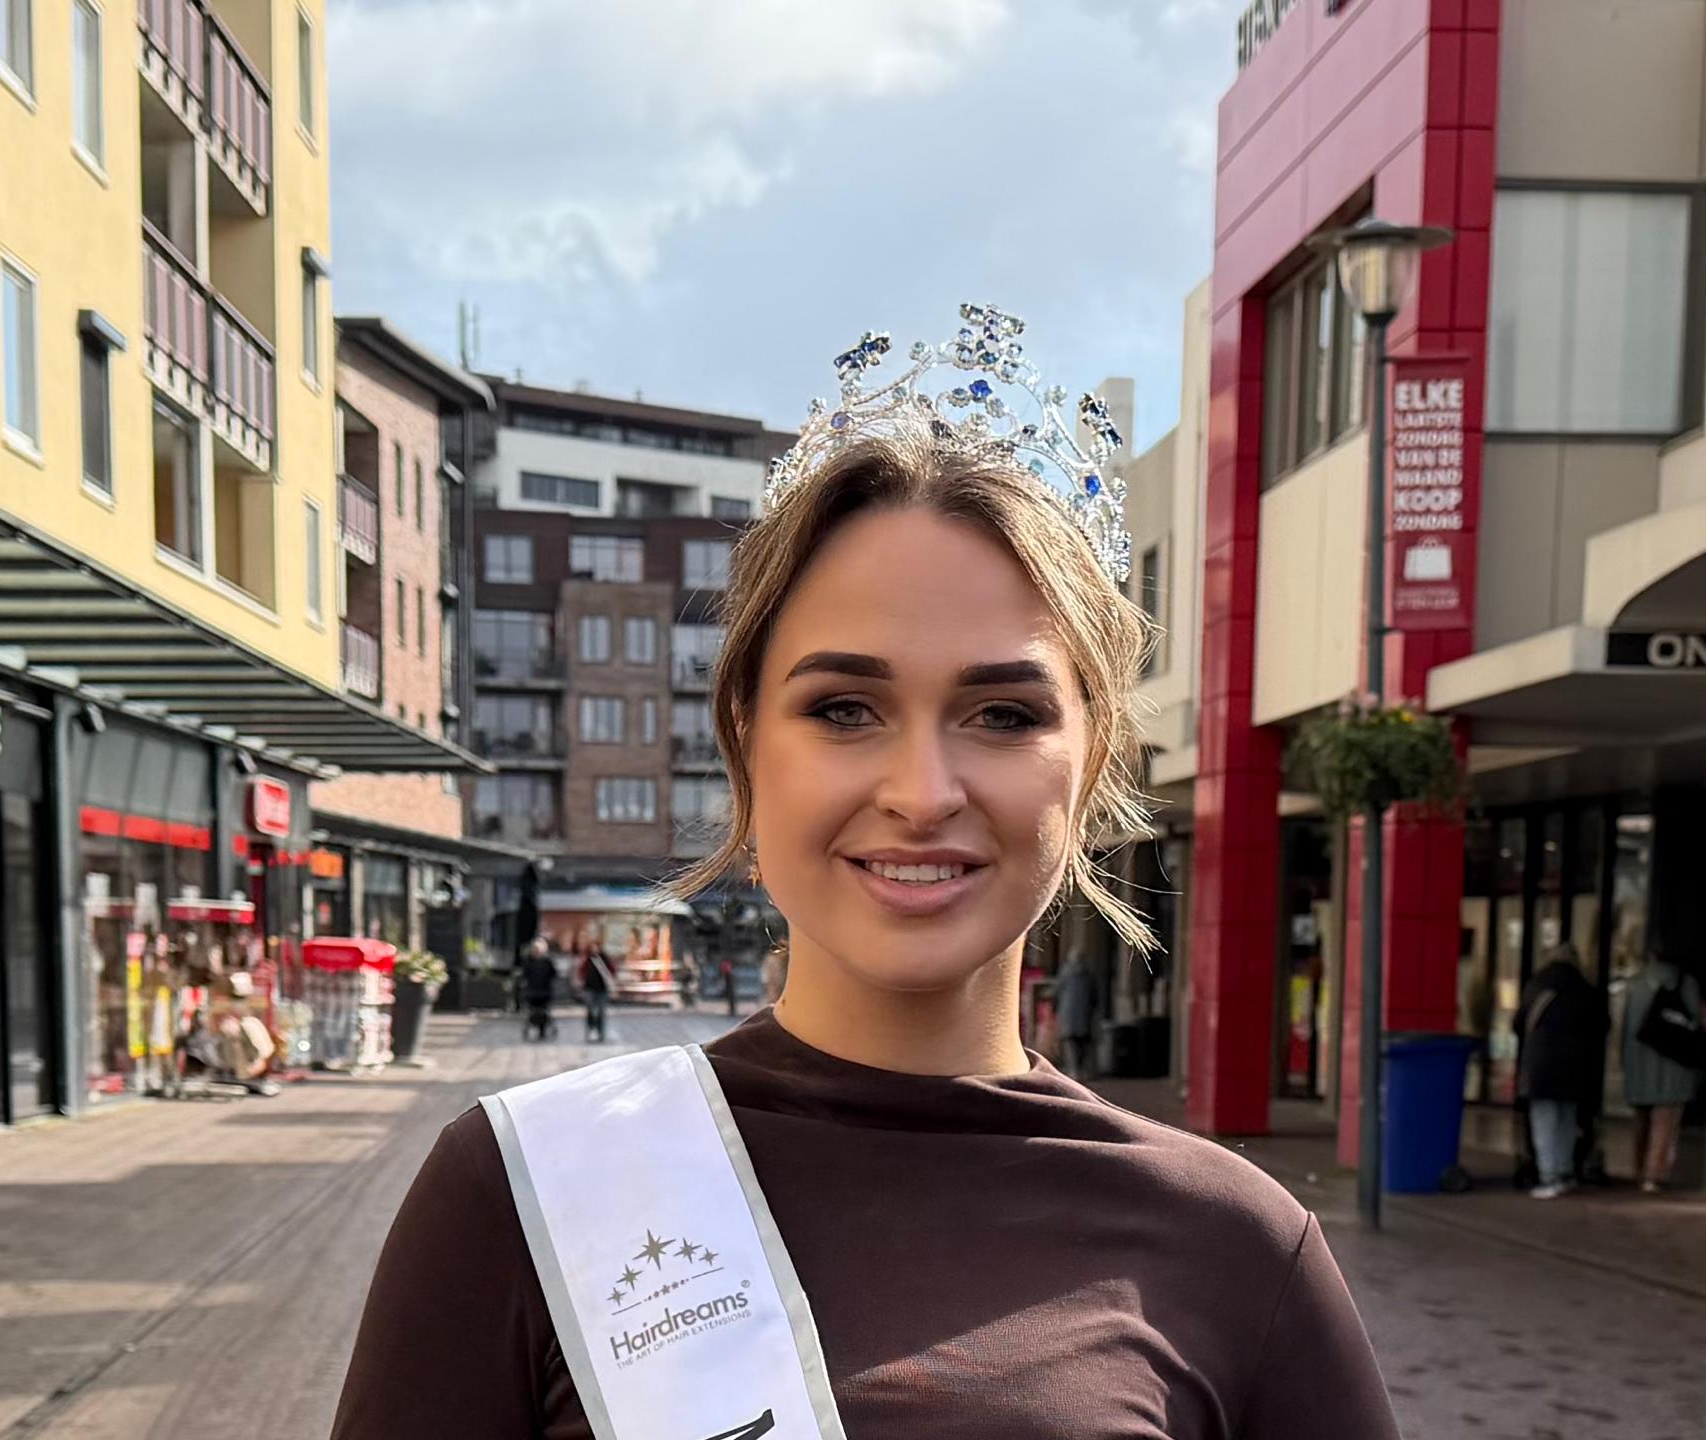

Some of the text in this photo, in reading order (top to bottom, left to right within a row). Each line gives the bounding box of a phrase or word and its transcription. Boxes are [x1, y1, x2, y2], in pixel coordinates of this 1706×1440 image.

[1395, 379, 1464, 411] ELKE
[1395, 488, 1462, 513] KOOP
[610, 1291, 749, 1360] Hairdreams
[617, 1309, 752, 1371] THE ART OF HAIR EXTENSIONS
